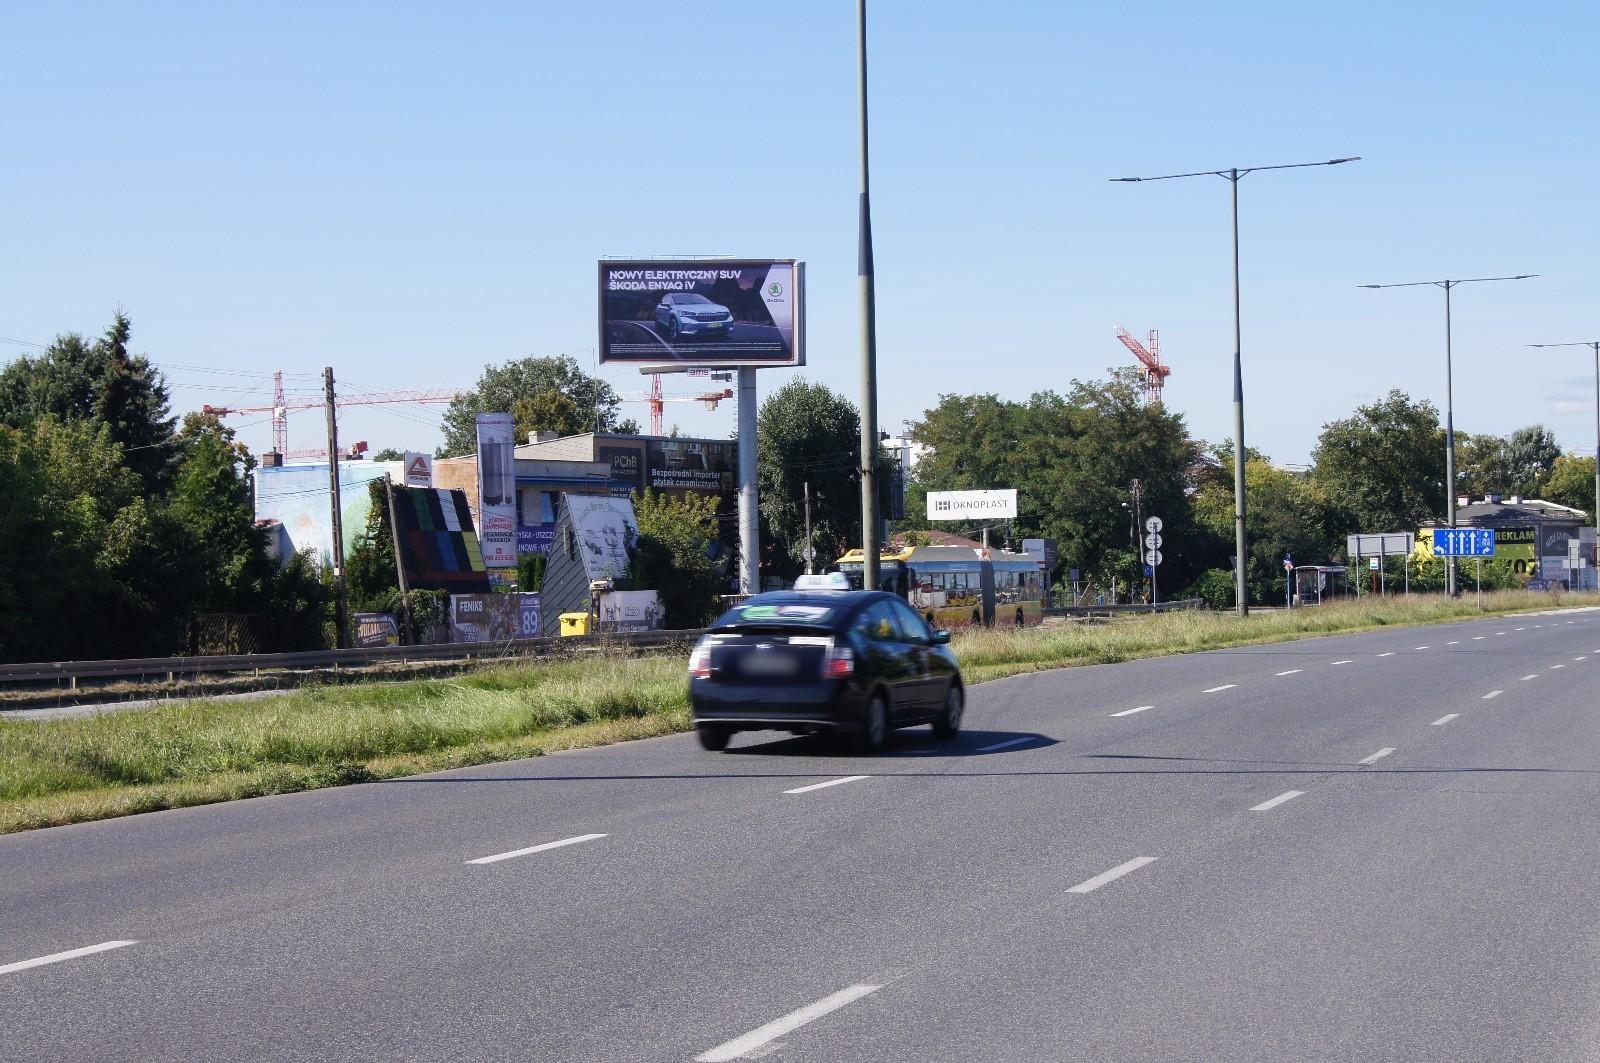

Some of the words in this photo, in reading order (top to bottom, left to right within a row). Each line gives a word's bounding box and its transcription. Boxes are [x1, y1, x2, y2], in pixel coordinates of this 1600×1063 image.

[609, 270, 644, 280] NOWY
[645, 270, 718, 279] ELEKTRYCZNY
[719, 270, 742, 279] SUV
[609, 280, 647, 290] ŠKODA
[648, 281, 683, 290] ENYAQ
[684, 281, 696, 290] iV
[690, 368, 709, 376] ams
[693, 470, 721, 480] importer
[953, 499, 1009, 510] OKNOPLAST
[1494, 531, 1536, 541] REKLAM
[459, 600, 483, 612] FENIKS
[522, 609, 538, 635] 89
